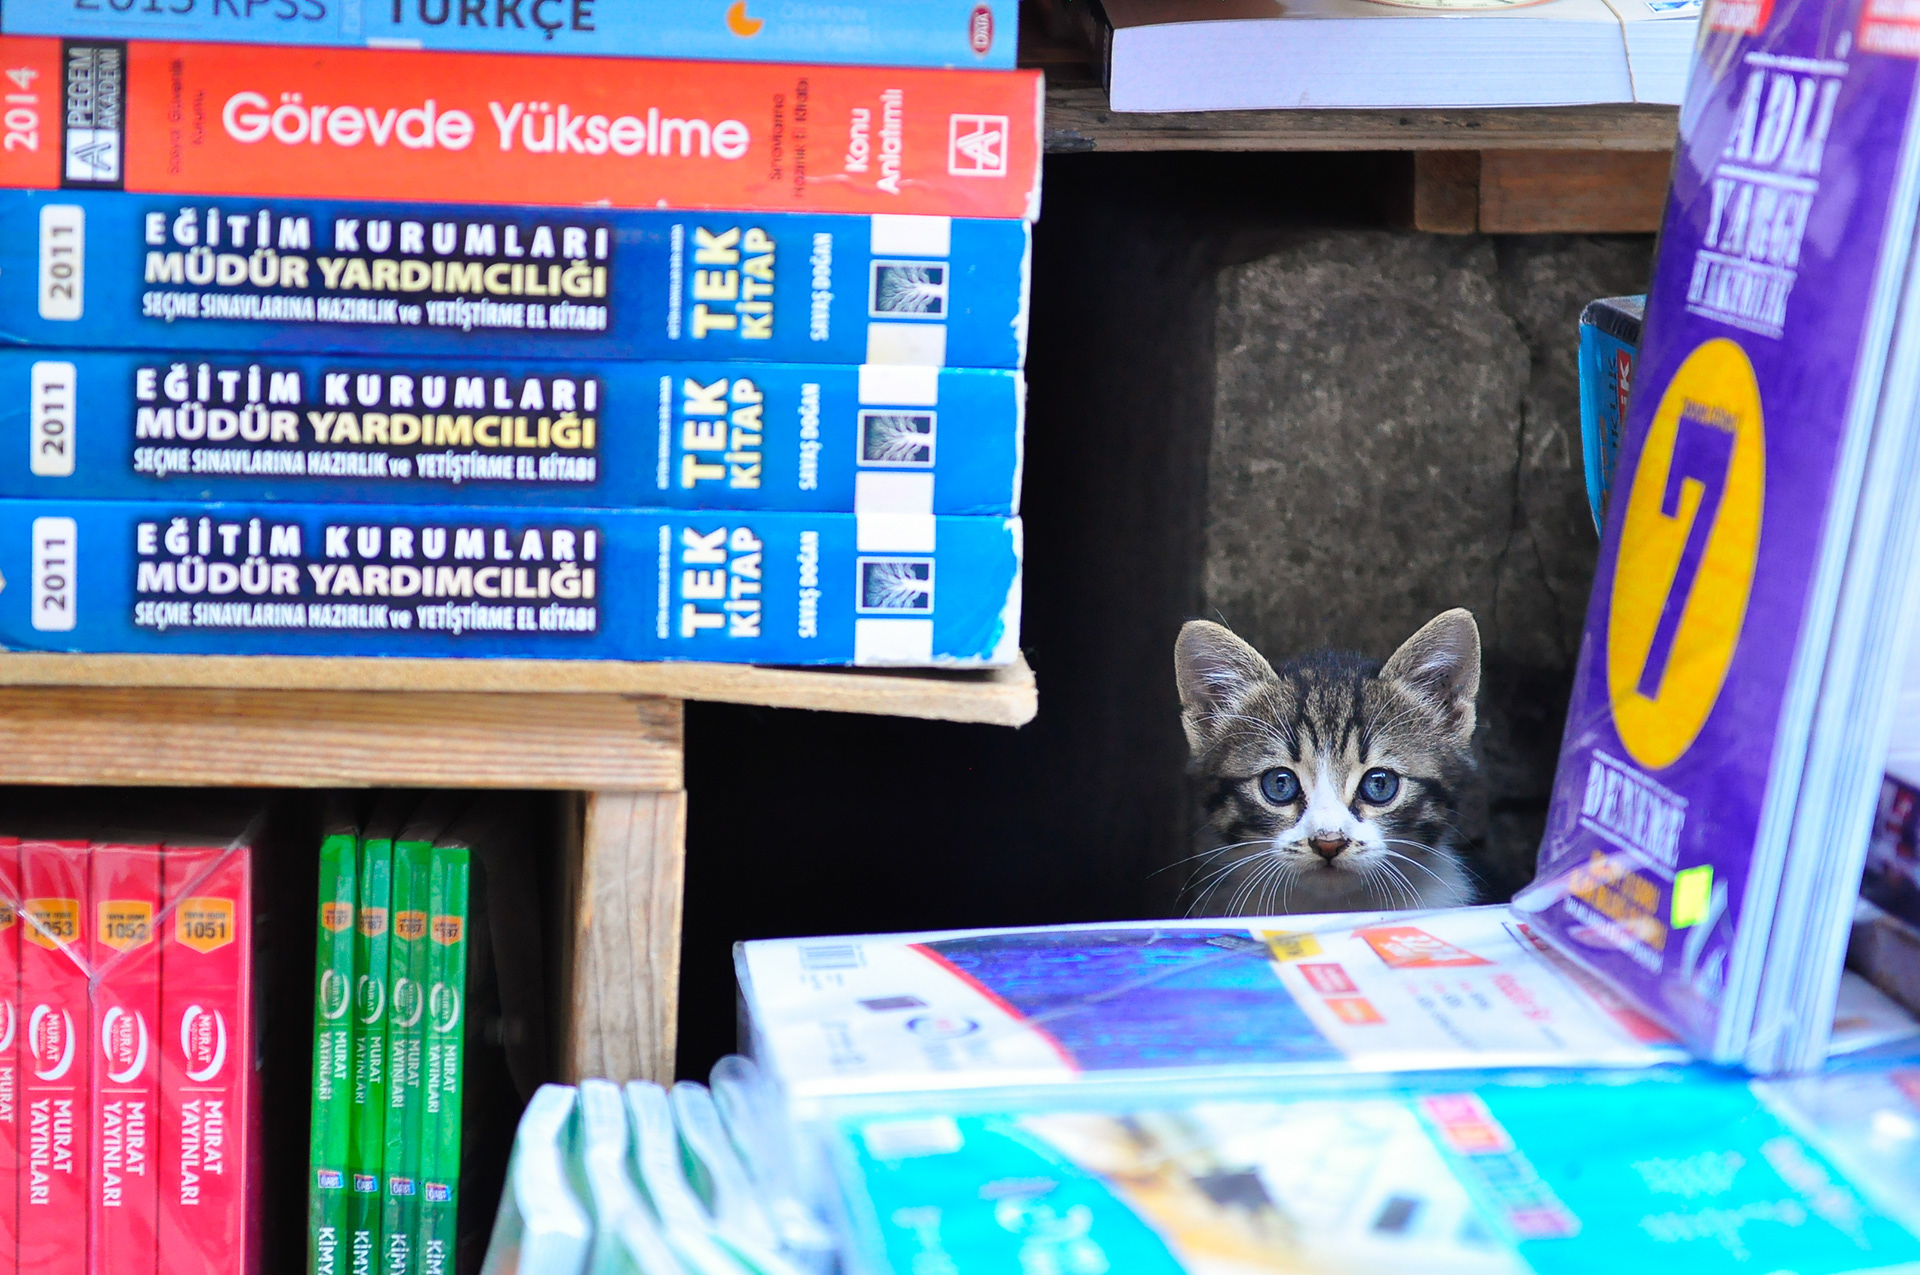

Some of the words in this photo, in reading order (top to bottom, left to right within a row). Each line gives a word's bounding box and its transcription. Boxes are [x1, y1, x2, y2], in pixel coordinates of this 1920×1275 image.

[4, 67, 38, 151] 2014
[68, 48, 93, 127] PEGEM
[222, 92, 475, 150] Görevde
[489, 101, 749, 159] Yükselme
[844, 108, 871, 172] Konu
[877, 88, 904, 195] Anlatımlı
[48, 224, 74, 297] 2011
[145, 207, 311, 249] EĞİTİM
[335, 219, 608, 259] KURUMLARI
[809, 233, 833, 289] DOĞAN
[145, 248, 309, 287] MÜDÜR
[317, 254, 607, 297] YARDIMCILIĞI
[692, 226, 741, 339] TEK
[735, 227, 775, 339] KİTAP
[143, 292, 198, 322] SEÇME
[201, 293, 315, 322] SINAVLARINA
[317, 297, 398, 325] HAZIRLIK
[399, 306, 421, 325] ve
[426, 297, 524, 332] YETİŞTİRME
[527, 305, 548, 328] EL
[549, 302, 607, 330] KİTABI
[810, 290, 835, 341] SAVAŞ
[41, 380, 66, 455] 2011
[136, 364, 301, 405] EĞİTİM
[325, 373, 597, 411] KURUMLARI
[797, 383, 820, 440] DOĞAN
[136, 402, 300, 442] MÜDÜR
[307, 409, 596, 449] YARDIMCILIĞI
[681, 378, 729, 489] TEK
[724, 378, 763, 489] KİTAP
[134, 447, 190, 477] SEÇME
[192, 449, 306, 476] SINAVLARINA
[308, 452, 388, 478] HAZIRLIK
[389, 459, 411, 478] ve
[416, 450, 514, 484] YETİŞTİRME
[516, 457, 537, 480] EL
[539, 454, 596, 482] KİTABI
[799, 441, 823, 490] SAVAŞ
[136, 517, 301, 557] EĞİTİM
[325, 526, 597, 562] KURUMLARI
[796, 531, 820, 587] DOĞAN
[41, 536, 66, 611] 2011
[136, 555, 300, 596] MÜDÜR
[307, 562, 596, 599] YARDIMCILIĞI
[682, 526, 728, 638] TEK
[724, 526, 763, 637] KİTAP
[135, 602, 190, 632] SEÇME
[193, 603, 306, 629] SINAVLARINA
[308, 606, 388, 631] HAZIRLIK
[389, 612, 412, 631] ve
[417, 602, 514, 636] YETİŞTİRME
[517, 609, 537, 632] EL
[539, 605, 596, 633] KİTABI
[798, 588, 822, 638] SAVAŞ
[46, 1013, 60, 1063] MURAT
[119, 1016, 133, 1065] MURAT
[197, 1014, 211, 1064] MURAT
[318, 1031, 332, 1100] YAYINLARI
[334, 1031, 347, 1080] MURAT
[355, 1037, 366, 1104] YAYINLARI
[370, 1036, 382, 1083] MURAT
[407, 1039, 421, 1087] MURAT
[443, 1045, 458, 1093] MURAT
[391, 1039, 405, 1107] YAYINLARI
[428, 1045, 442, 1113] YAYINLARI
[30, 1099, 49, 1205] YAYINLARI
[54, 1100, 73, 1174] MURAT
[103, 1101, 122, 1207] YAYINLARI
[127, 1101, 146, 1176] MURAT
[181, 1100, 199, 1206] YAYINLARI
[205, 1100, 223, 1175] MURAT
